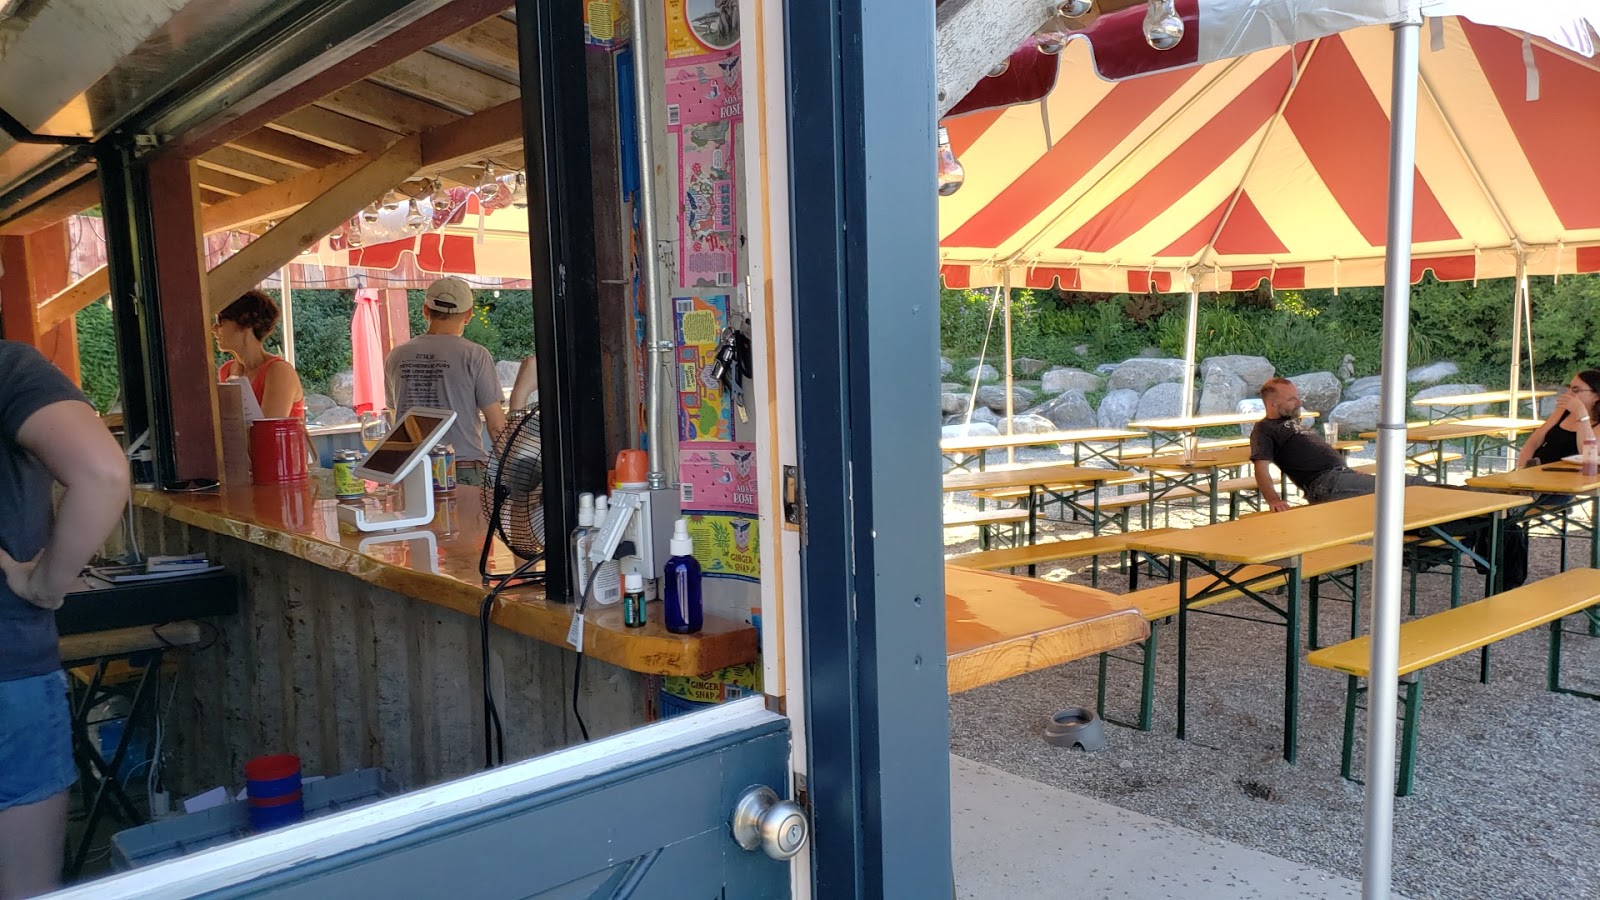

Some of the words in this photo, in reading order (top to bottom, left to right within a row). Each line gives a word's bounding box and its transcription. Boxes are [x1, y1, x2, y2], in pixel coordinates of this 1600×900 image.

[730, 553, 754, 565] GINGER
[734, 562, 751, 572] SNAP
[690, 681, 720, 691] GINGER
[695, 691, 715, 700] SNAP
